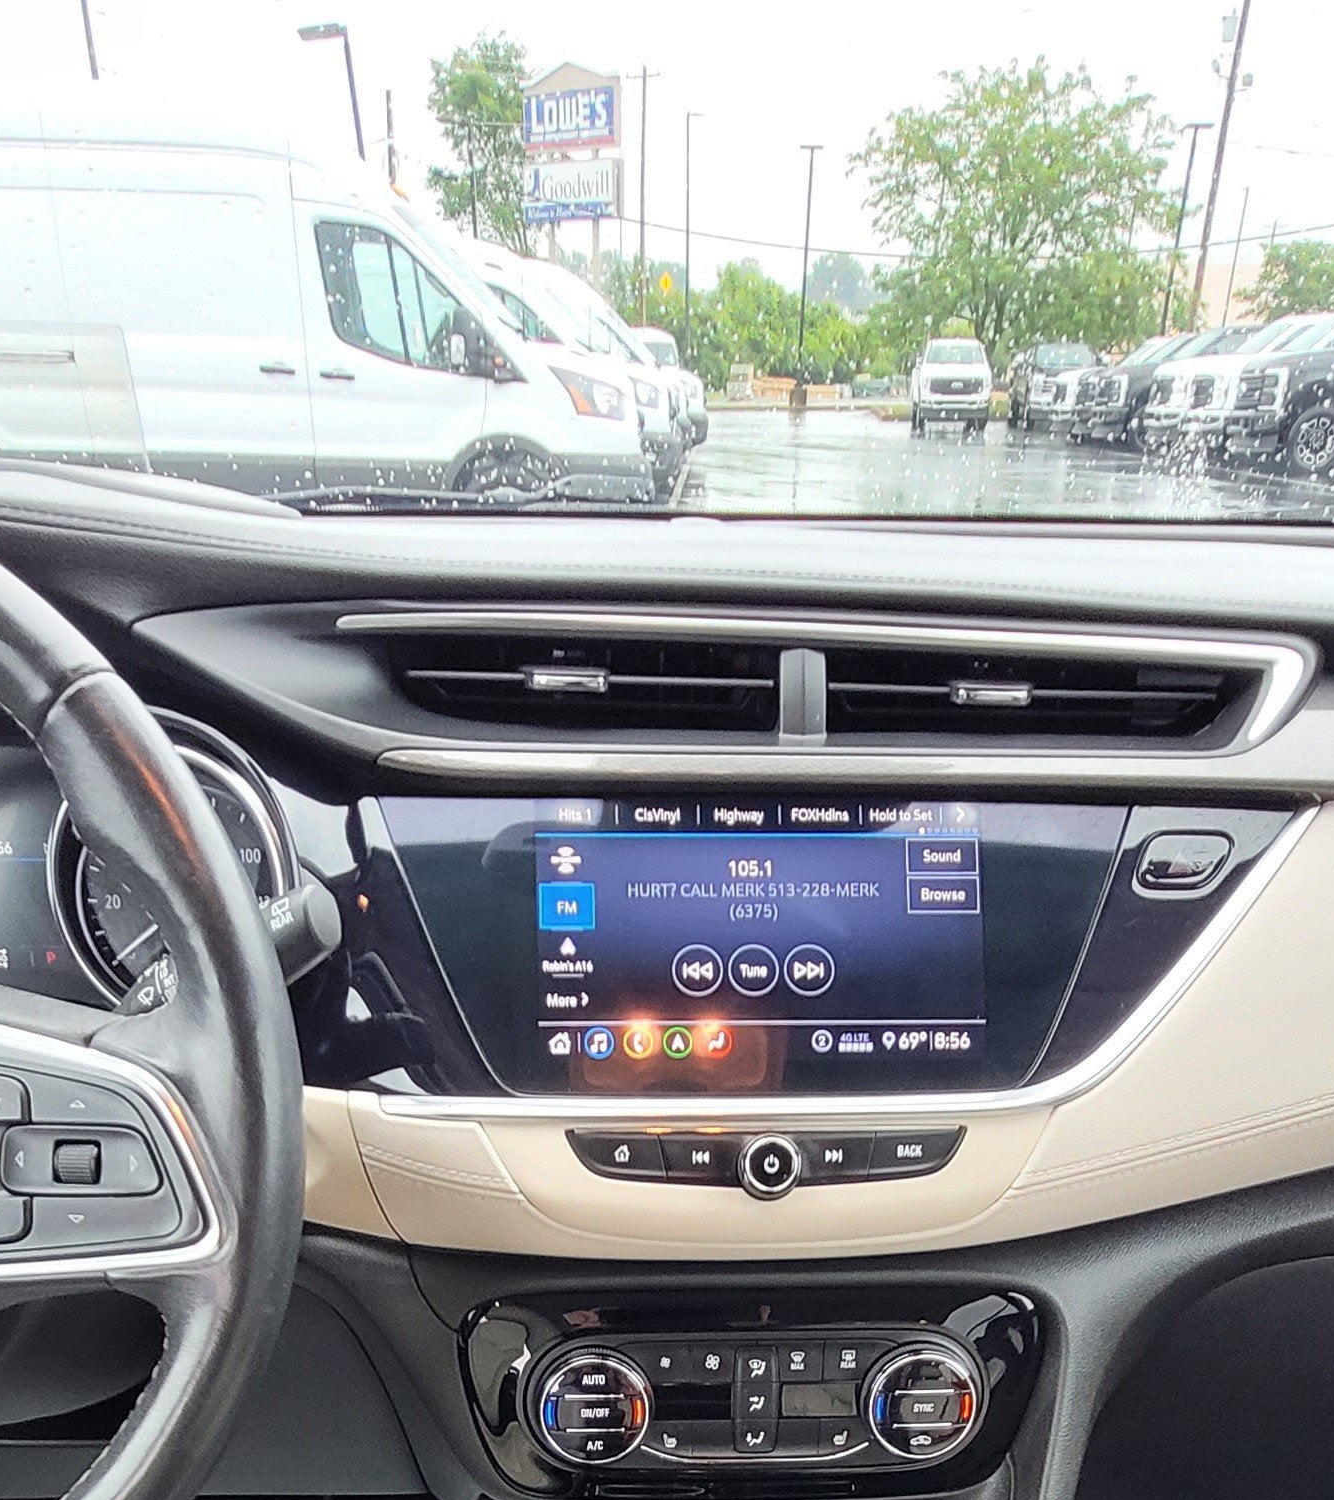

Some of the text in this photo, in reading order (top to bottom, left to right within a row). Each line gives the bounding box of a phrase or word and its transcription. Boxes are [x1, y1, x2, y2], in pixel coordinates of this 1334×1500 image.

[530, 89, 608, 134] LOWE'S
[542, 170, 610, 202] Goodwill
[558, 807, 592, 822] Hits 1
[713, 807, 765, 827] Highway
[869, 807, 933, 822] Hold to Set
[240, 848, 262, 864] 100
[922, 848, 962, 864] Sound
[727, 859, 773, 877] 105.1
[627, 882, 880, 898] HURT? CALL MERK 513-228-MERK
[920, 887, 966, 902] Browse
[104, 894, 122, 910] 20
[556, 901, 578, 915] FM
[729, 903, 779, 921] (6375)
[270, 911, 295, 931] REAR
[739, 963, 768, 979] Tune
[546, 992, 578, 1008] More
[853, 1032, 870, 1042] LTE
[934, 1031, 971, 1050] 8:56
[896, 1144, 923, 1158] BACK
[581, 1374, 606, 1385] AUTO
[580, 1407, 610, 1418] ON/OFF
[912, 1403, 935, 1413] SYNC
[586, 1440, 604, 1450] A/C
